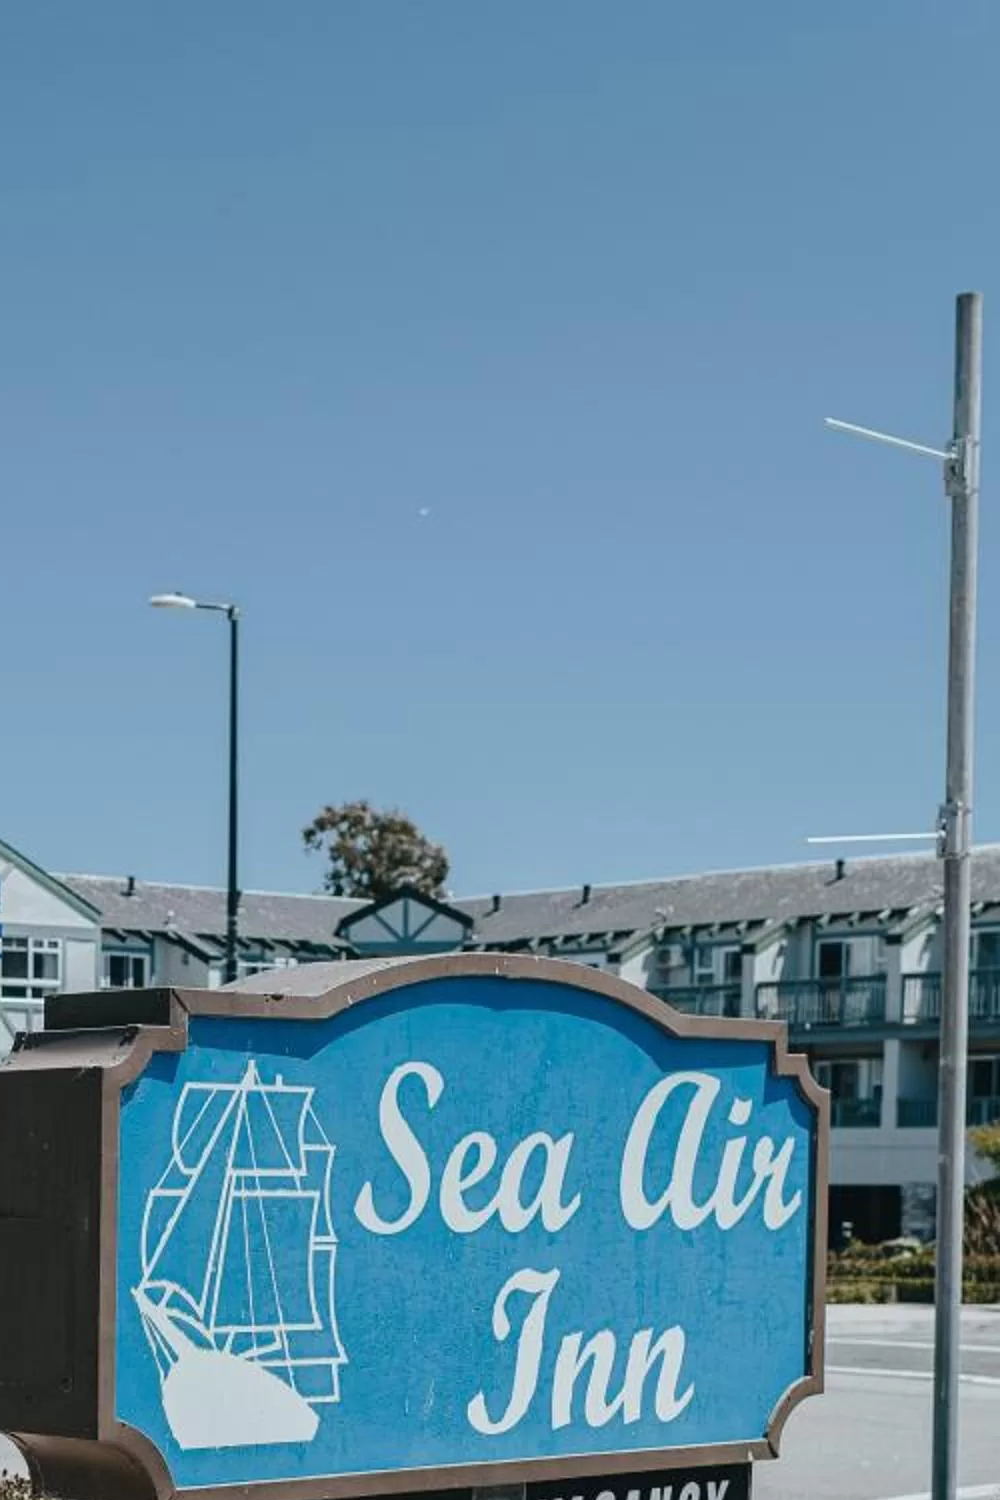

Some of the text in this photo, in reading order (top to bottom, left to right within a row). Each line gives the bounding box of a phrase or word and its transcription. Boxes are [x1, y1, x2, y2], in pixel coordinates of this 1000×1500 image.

[354, 1061, 802, 1234] Sea Air
[466, 1266, 695, 1436] Inn
